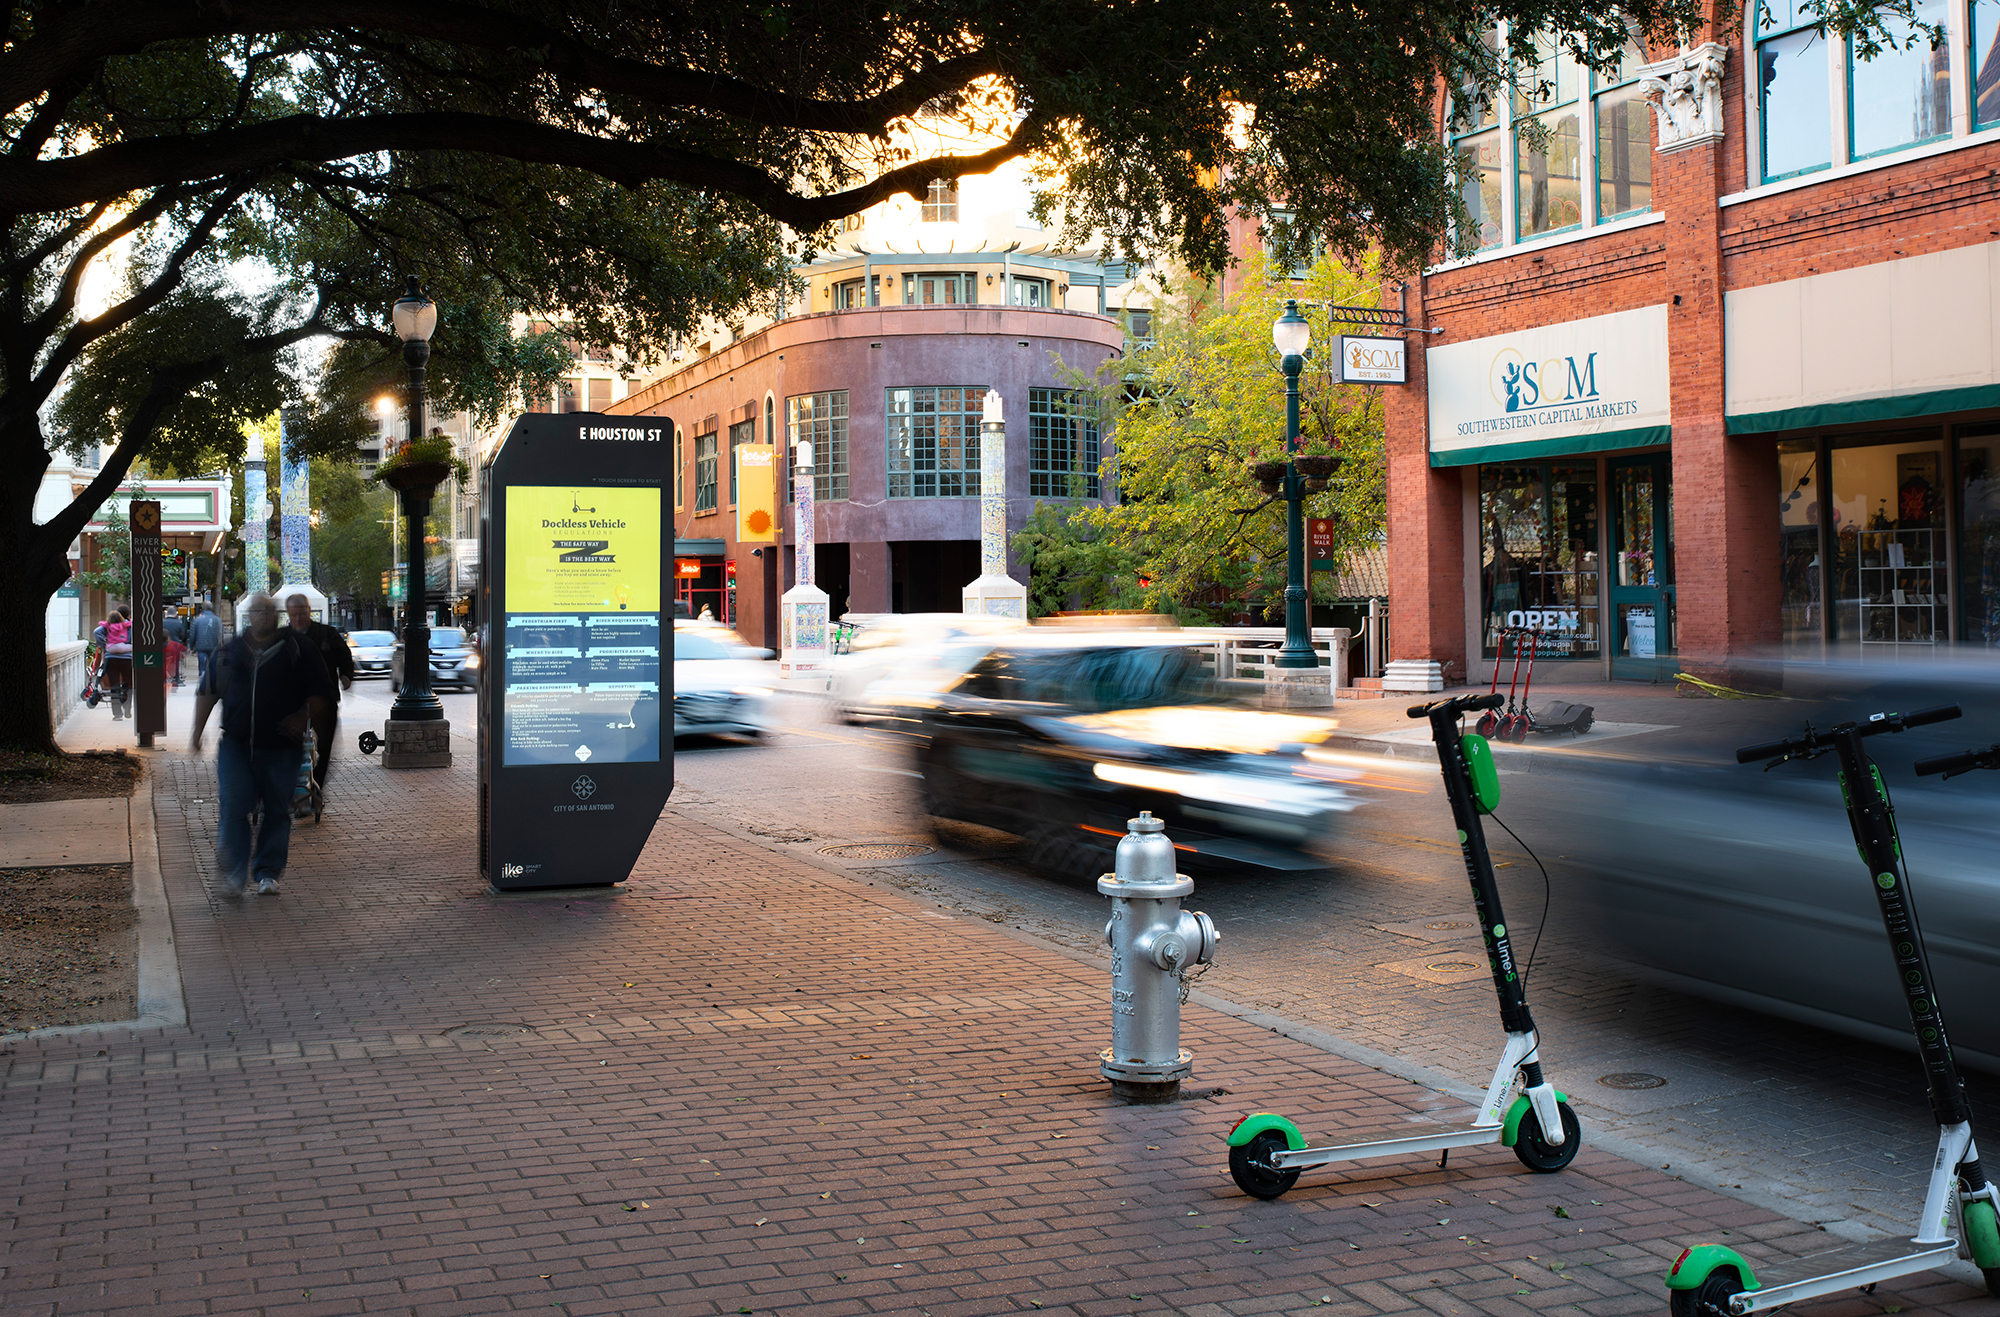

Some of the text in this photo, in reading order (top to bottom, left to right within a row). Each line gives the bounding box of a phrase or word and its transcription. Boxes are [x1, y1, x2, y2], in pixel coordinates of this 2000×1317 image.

[1362, 349, 1400, 368] SCM
[1523, 352, 1599, 405] SCM
[1458, 400, 1637, 435] SOUTHWESTERN CAPITAL MARKETS
[580, 427, 661, 441] E HOUSTON ST
[542, 519, 626, 528] Dockless Vehicle
[1630, 606, 1655, 617] OPE
[1508, 610, 1579, 630] OPEN
[1632, 635, 1655, 646] Welco
